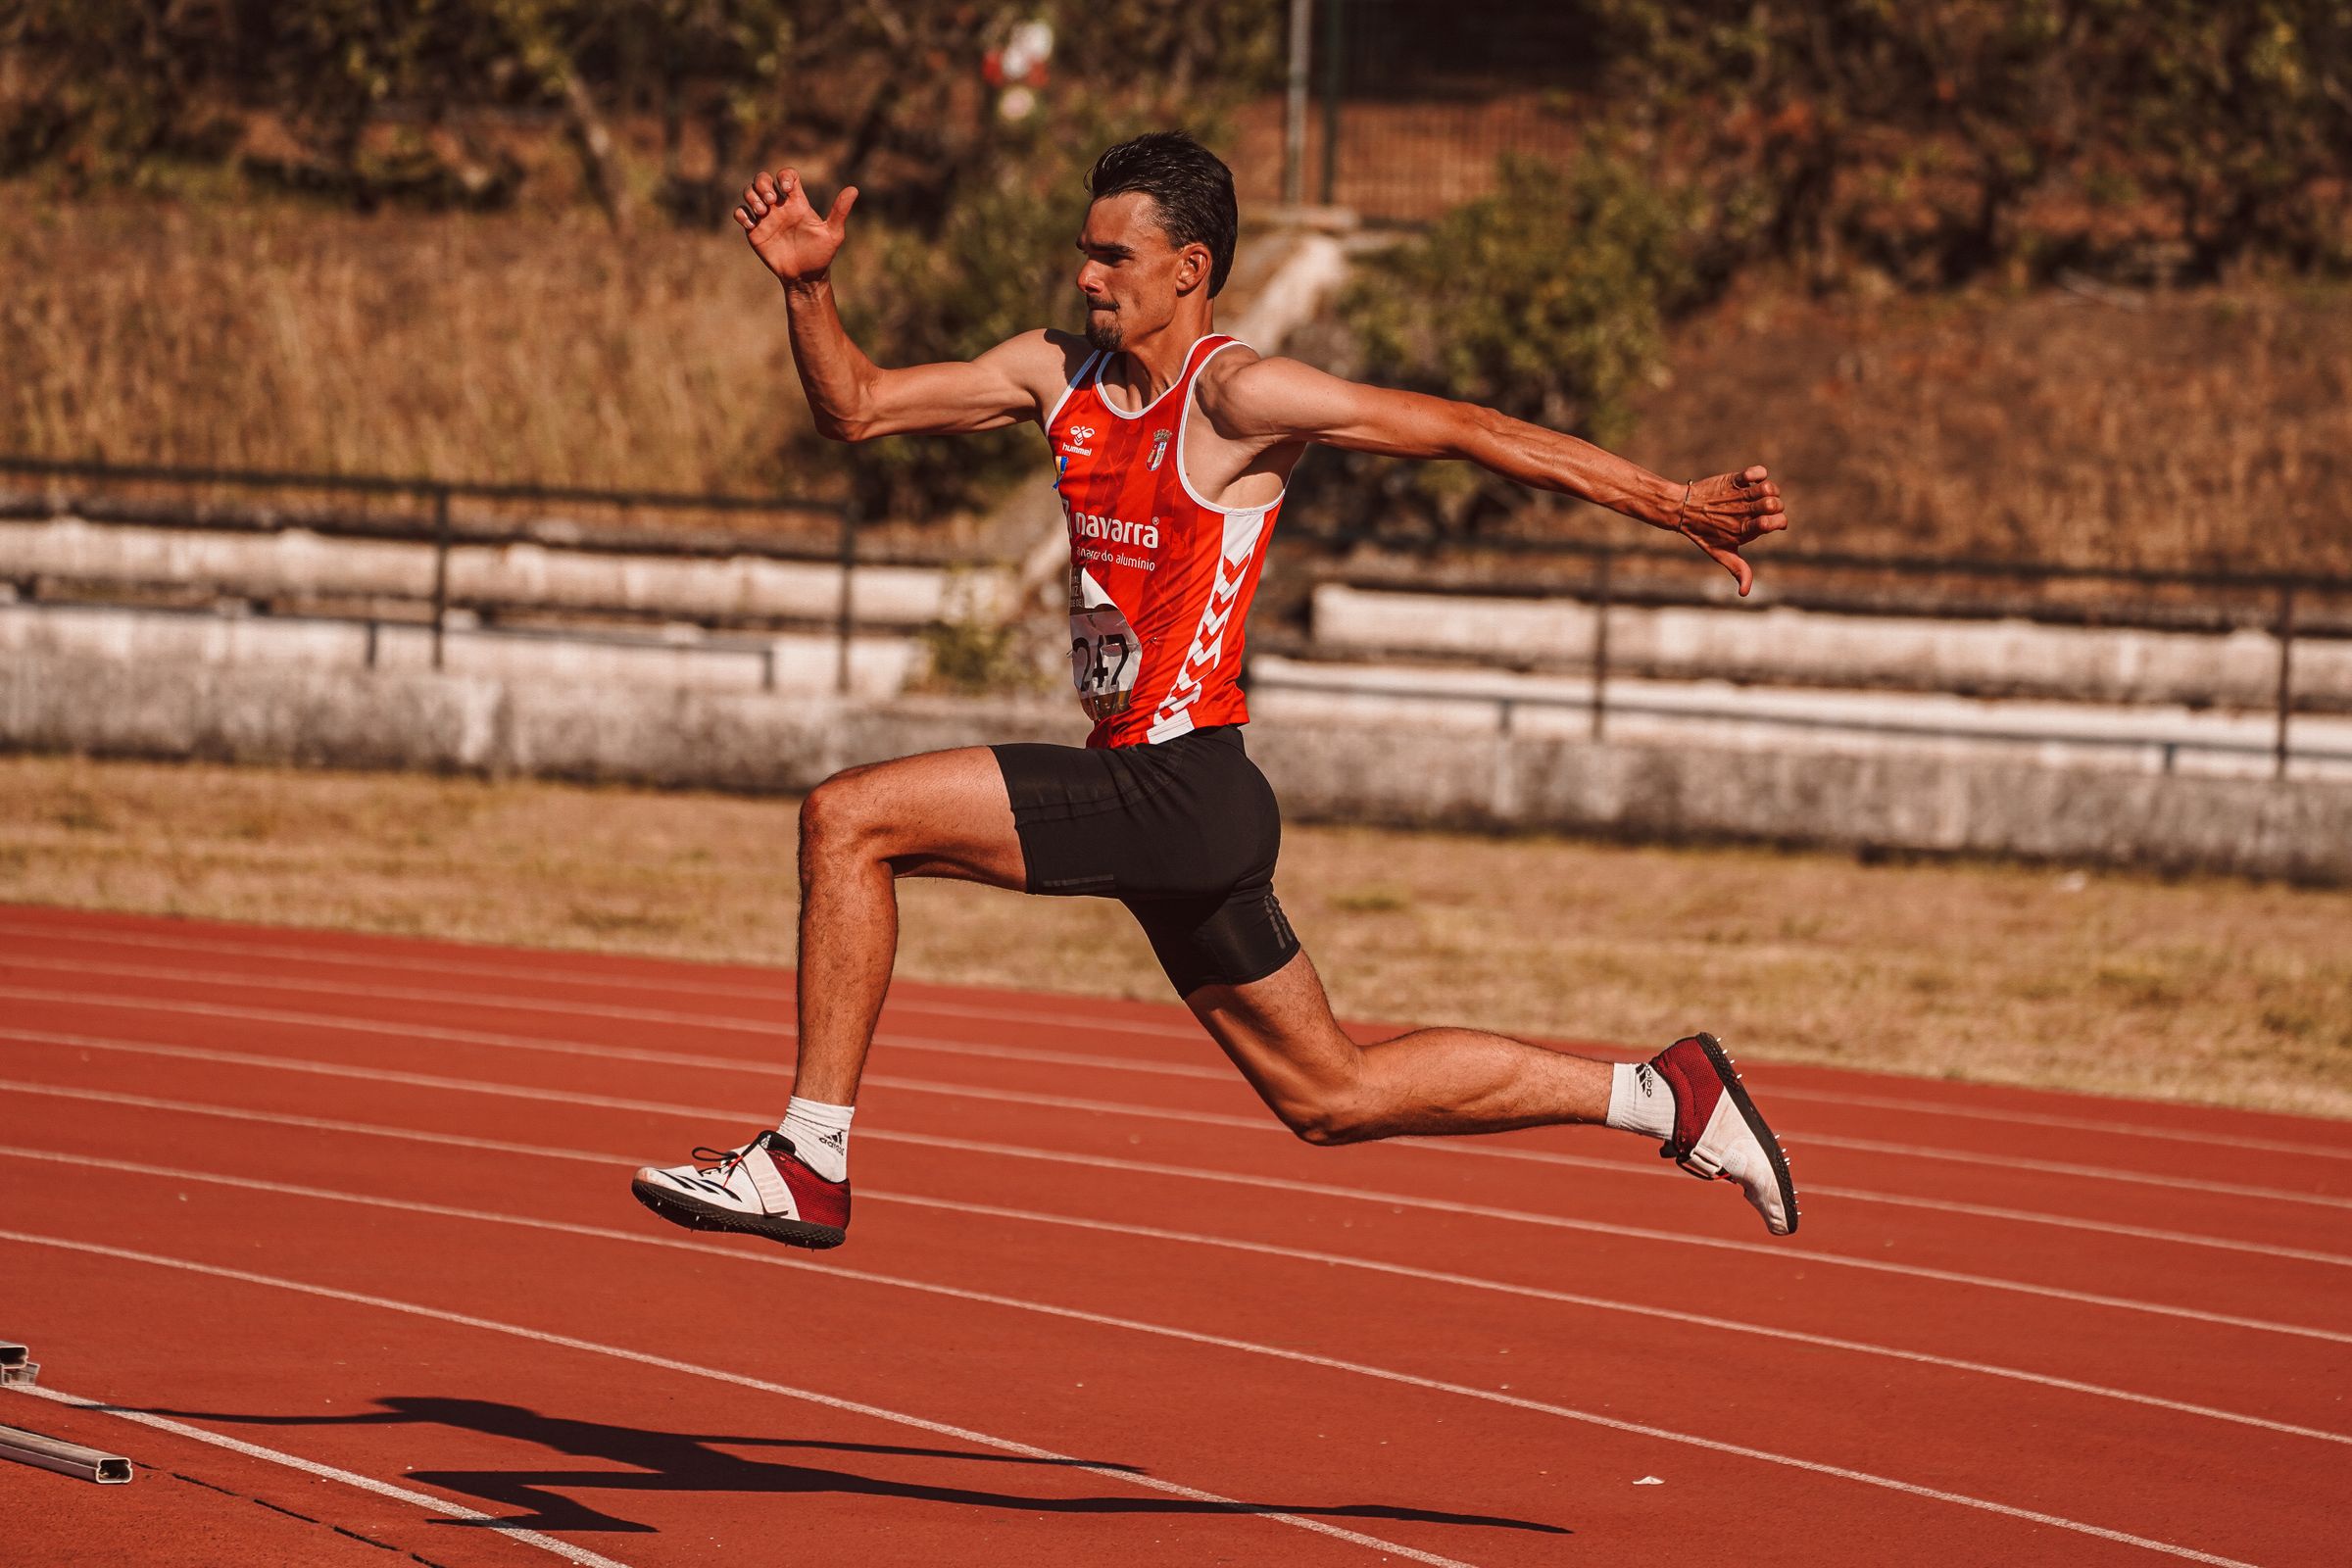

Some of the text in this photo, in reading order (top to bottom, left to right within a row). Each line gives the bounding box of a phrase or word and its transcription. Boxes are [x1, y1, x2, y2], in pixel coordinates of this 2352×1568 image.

[1061, 441, 1093, 457] hummel
[1101, 550, 1114, 563] do
[1115, 552, 1155, 571] alumínio
[1072, 633, 1130, 692] 247
